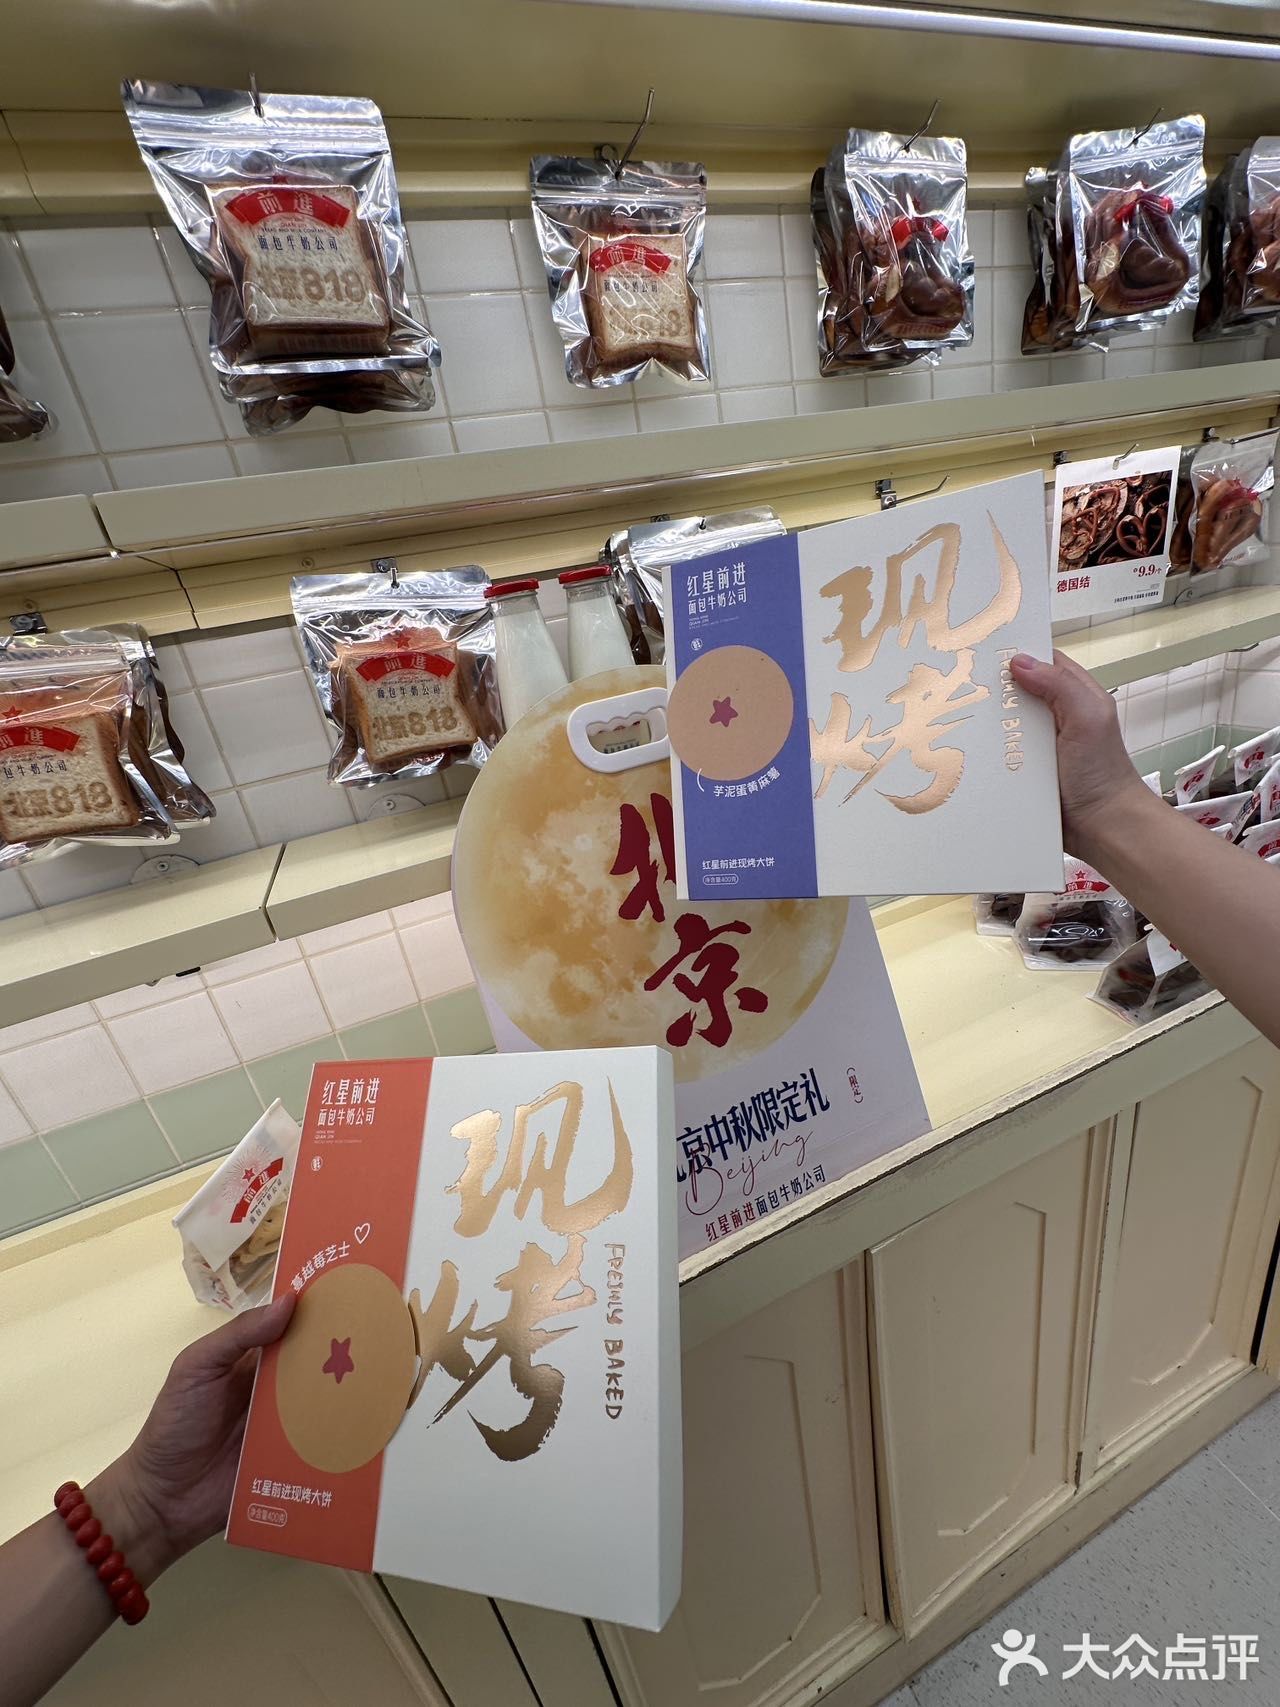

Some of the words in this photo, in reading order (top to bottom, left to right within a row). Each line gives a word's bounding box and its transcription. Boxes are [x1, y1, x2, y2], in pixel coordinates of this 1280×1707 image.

[687, 562, 746, 597] 红星前进
[1057, 576, 1091, 593] 德国结
[688, 587, 747, 615] 面包牛奶公司
[1000, 717, 1024, 773] BAKED
[713, 766, 780, 798] 芋泥蛋黄麻薯
[702, 857, 775, 870] 红星前进现烤大饼
[321, 1077, 380, 1105] 红星前进
[317, 1107, 376, 1126] 面包牛奶公司
[676, 1068, 831, 1183] 京中秋限定礼
[686, 1131, 814, 1216] Beijing
[291, 1241, 350, 1295] 蔓越莓芝士
[604, 1339, 626, 1420] BAKED
[251, 1478, 332, 1508] 红星前进现烤大饼
